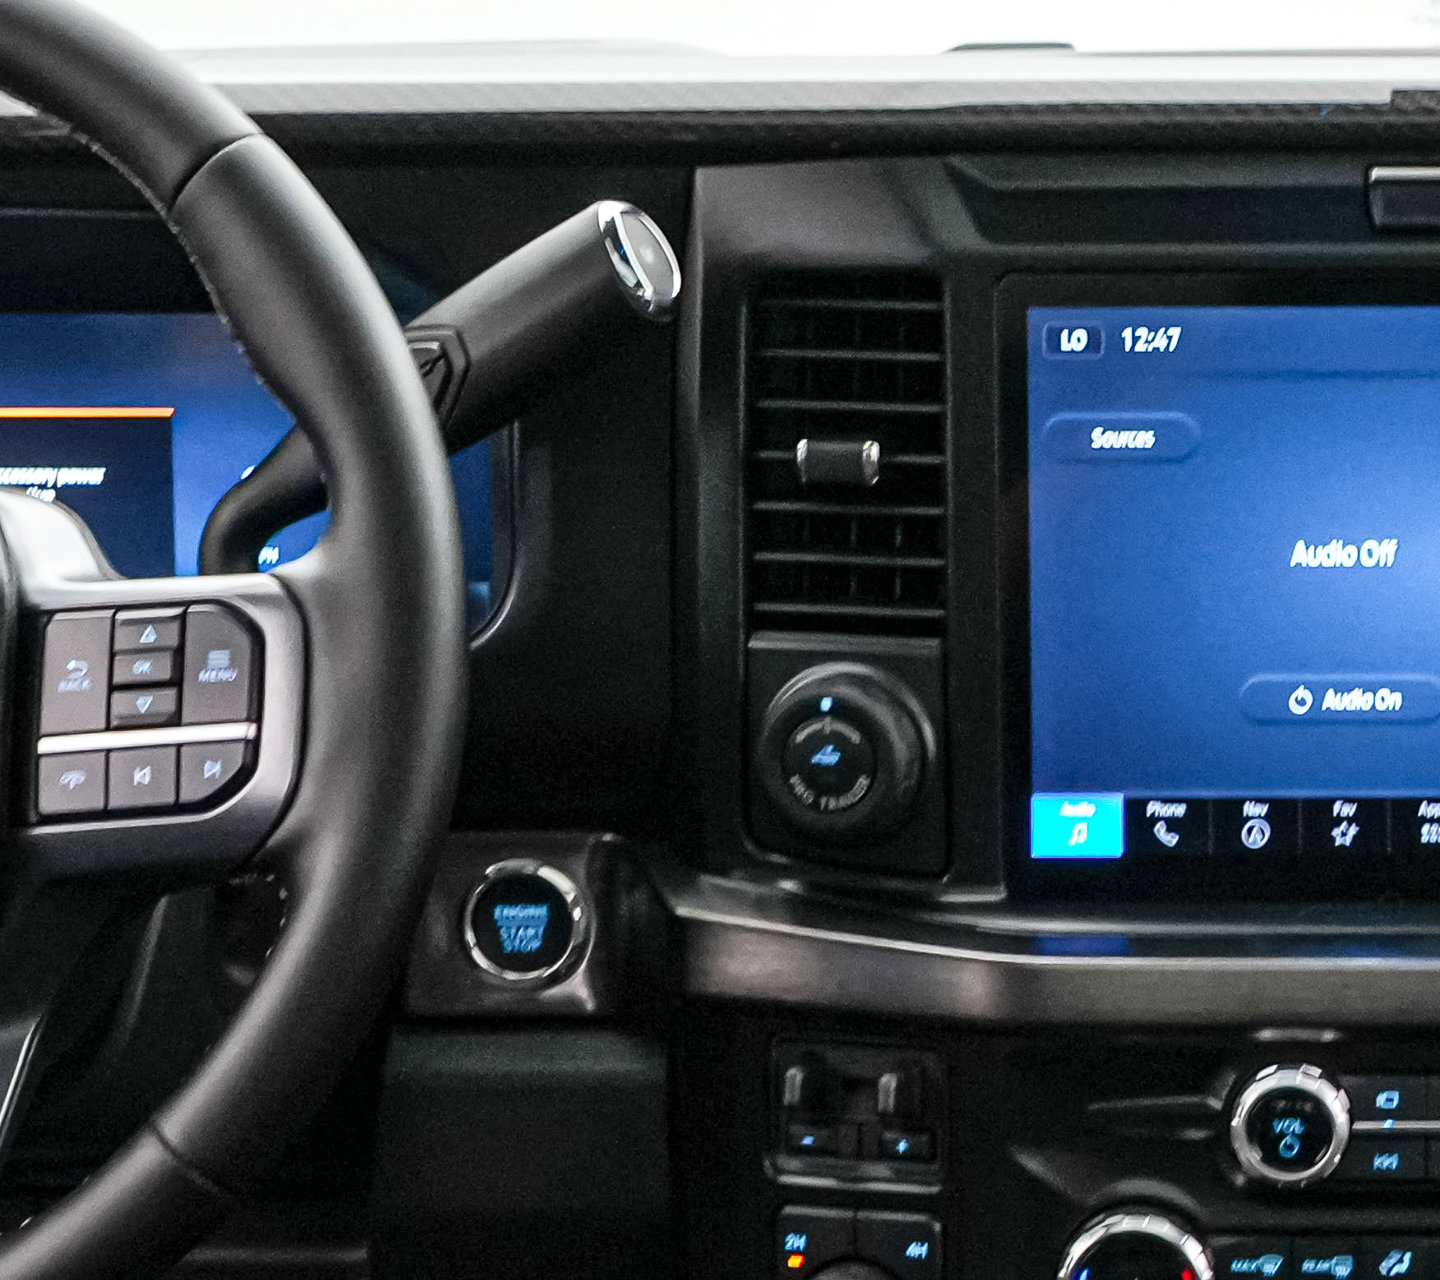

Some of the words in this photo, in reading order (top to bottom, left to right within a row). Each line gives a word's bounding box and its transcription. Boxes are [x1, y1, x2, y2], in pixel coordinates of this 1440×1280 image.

[1060, 328, 1089, 352] LO
[1120, 327, 1182, 352] 12:47
[1091, 426, 1156, 449] Sources
[1289, 538, 1358, 568] Audio
[1359, 538, 1399, 568] Off
[199, 667, 238, 683] MENU
[1321, 687, 1374, 711] Audio
[1374, 687, 1404, 711] On
[1146, 800, 1187, 818] Phone
[1243, 800, 1270, 818] Nav
[1332, 800, 1358, 818] Fav
[1273, 1118, 1305, 1135] VOL
